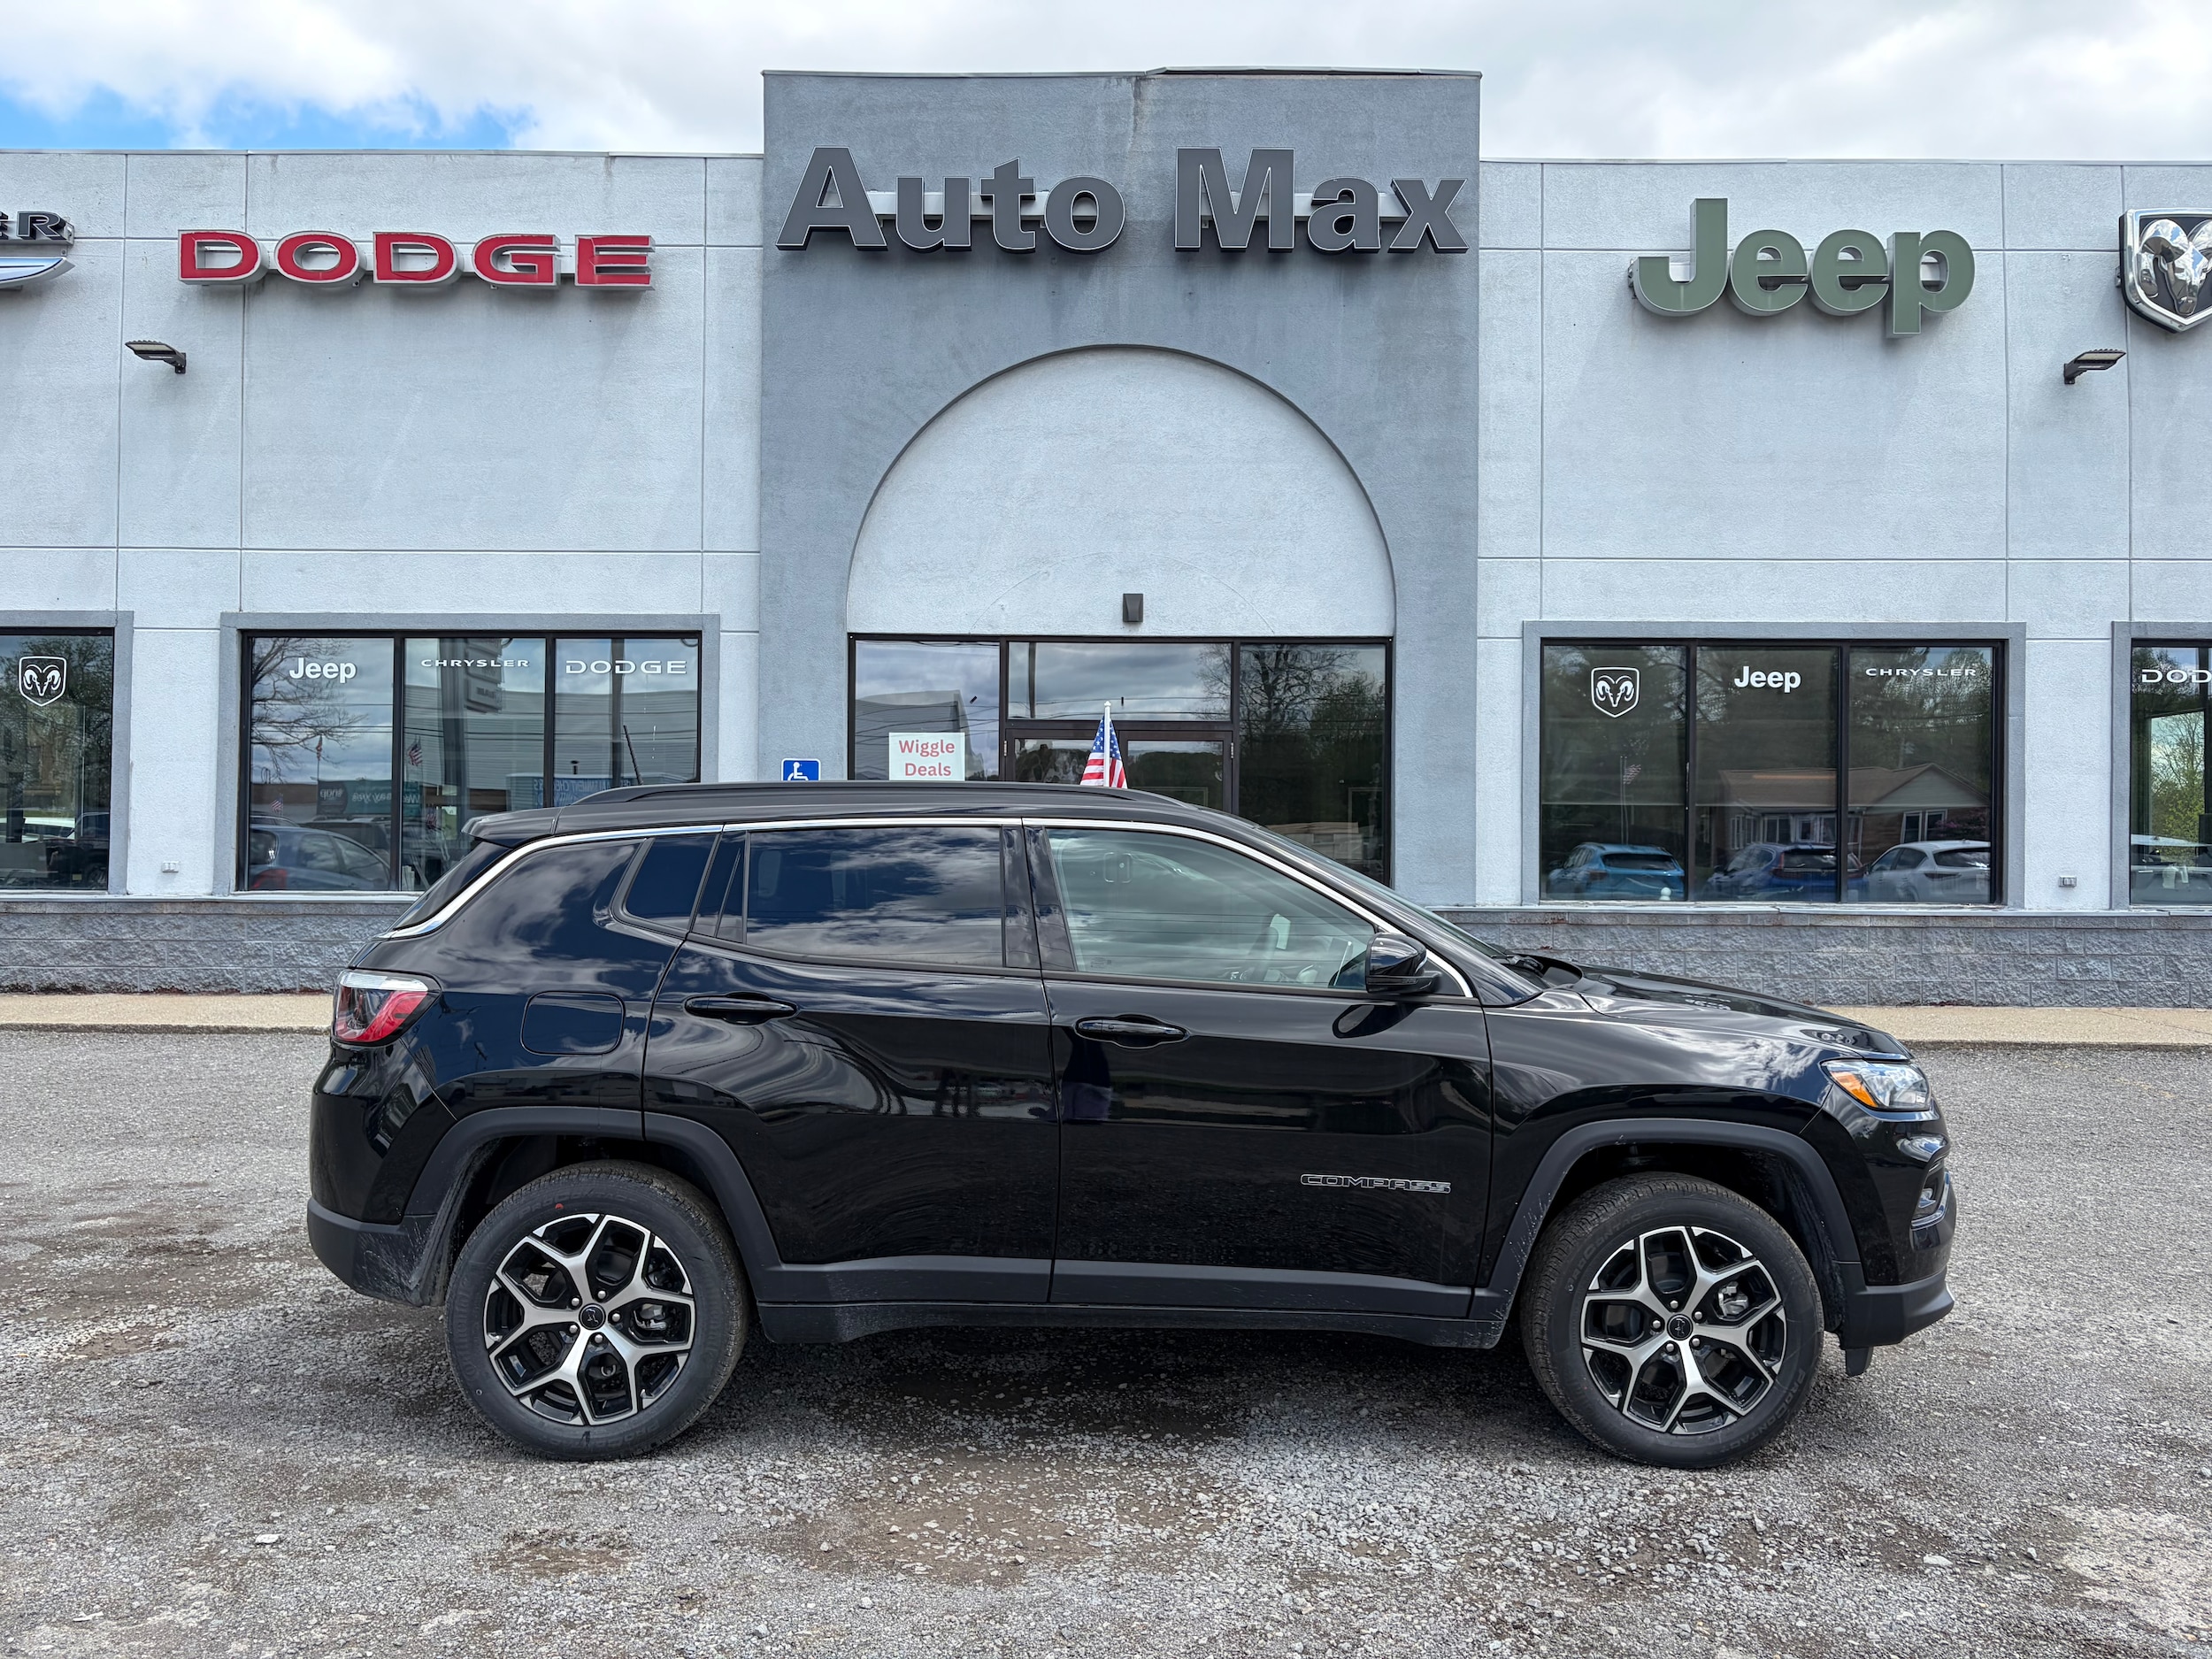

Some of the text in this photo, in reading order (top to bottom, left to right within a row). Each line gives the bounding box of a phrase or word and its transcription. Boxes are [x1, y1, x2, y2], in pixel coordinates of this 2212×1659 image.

[775, 145, 1470, 255] Auto Max
[179, 230, 655, 290] DODGE
[1634, 197, 1976, 337] Jeep
[288, 657, 357, 684] Jeep
[420, 658, 530, 668] CHRYSLER
[565, 660, 687, 674] DODGE
[1865, 667, 1978, 677] CHRYSLER
[1733, 665, 1801, 693] Jeep
[898, 739, 955, 757] Wiggle
[904, 762, 952, 777] Deals
[1301, 1173, 1451, 1194] COMPASS
